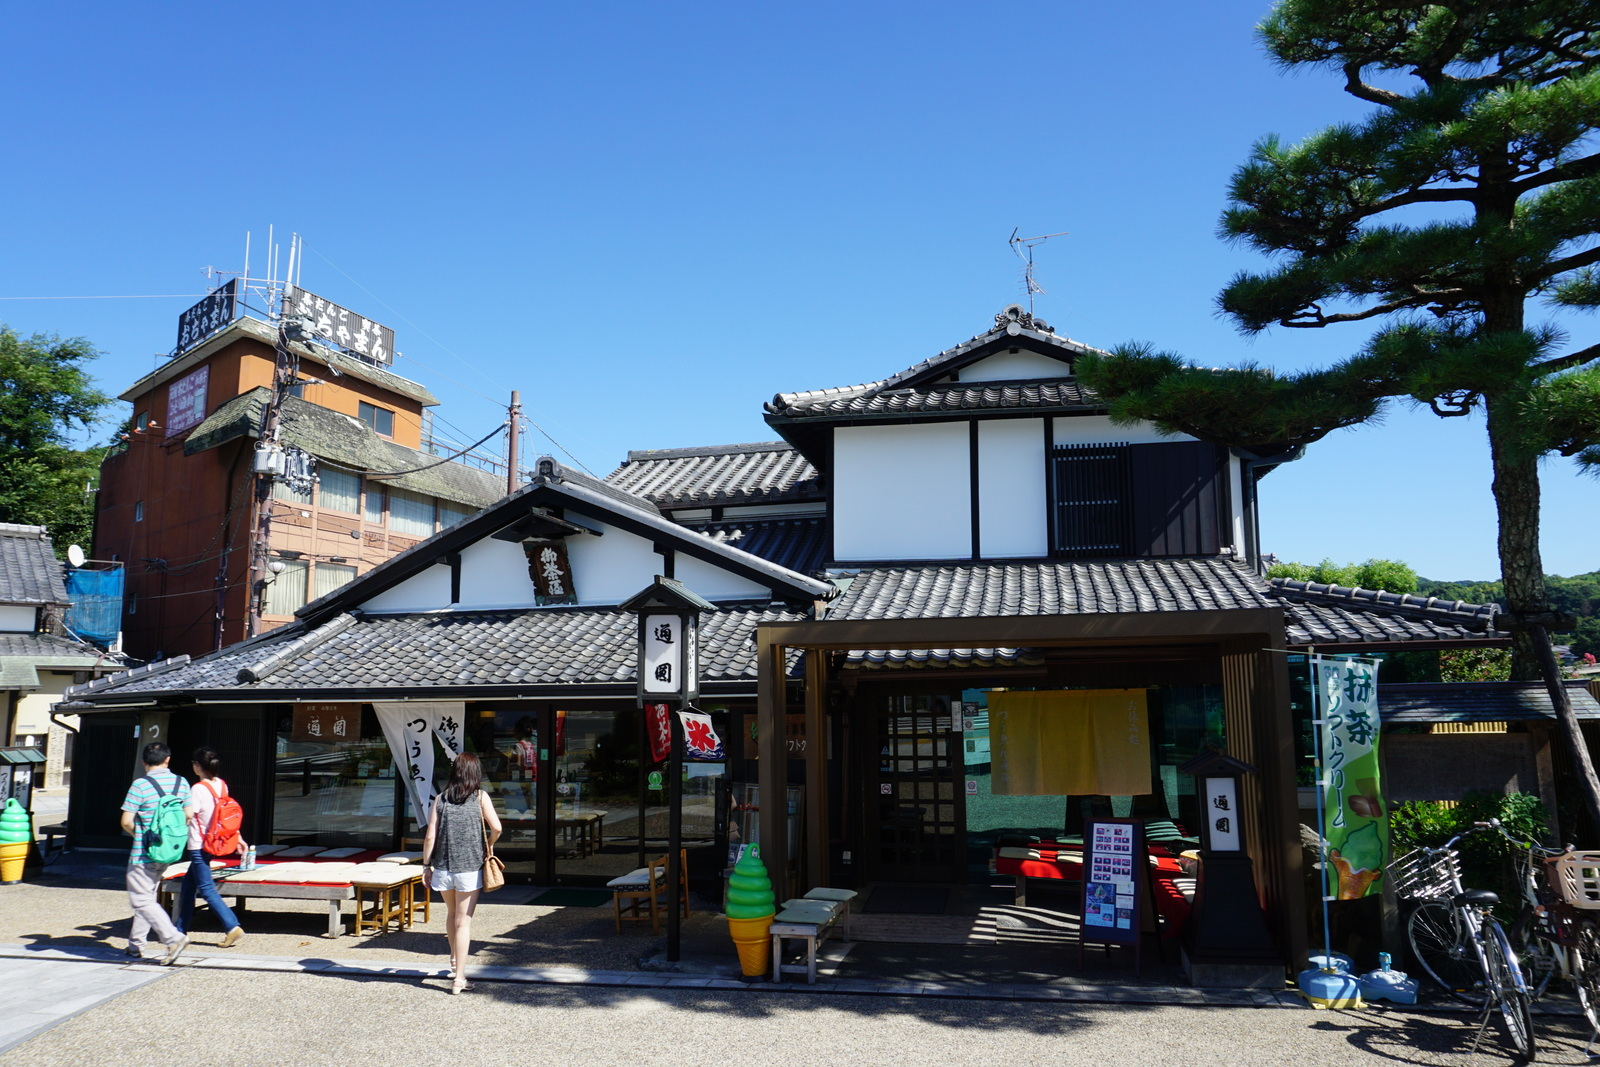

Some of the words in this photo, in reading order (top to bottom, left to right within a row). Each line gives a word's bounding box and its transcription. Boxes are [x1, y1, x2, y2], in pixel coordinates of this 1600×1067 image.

[685, 719, 717, 752] 氷
[1343, 667, 1374, 746] 抹茶
[1327, 695, 1346, 828] ソフトクリーム
